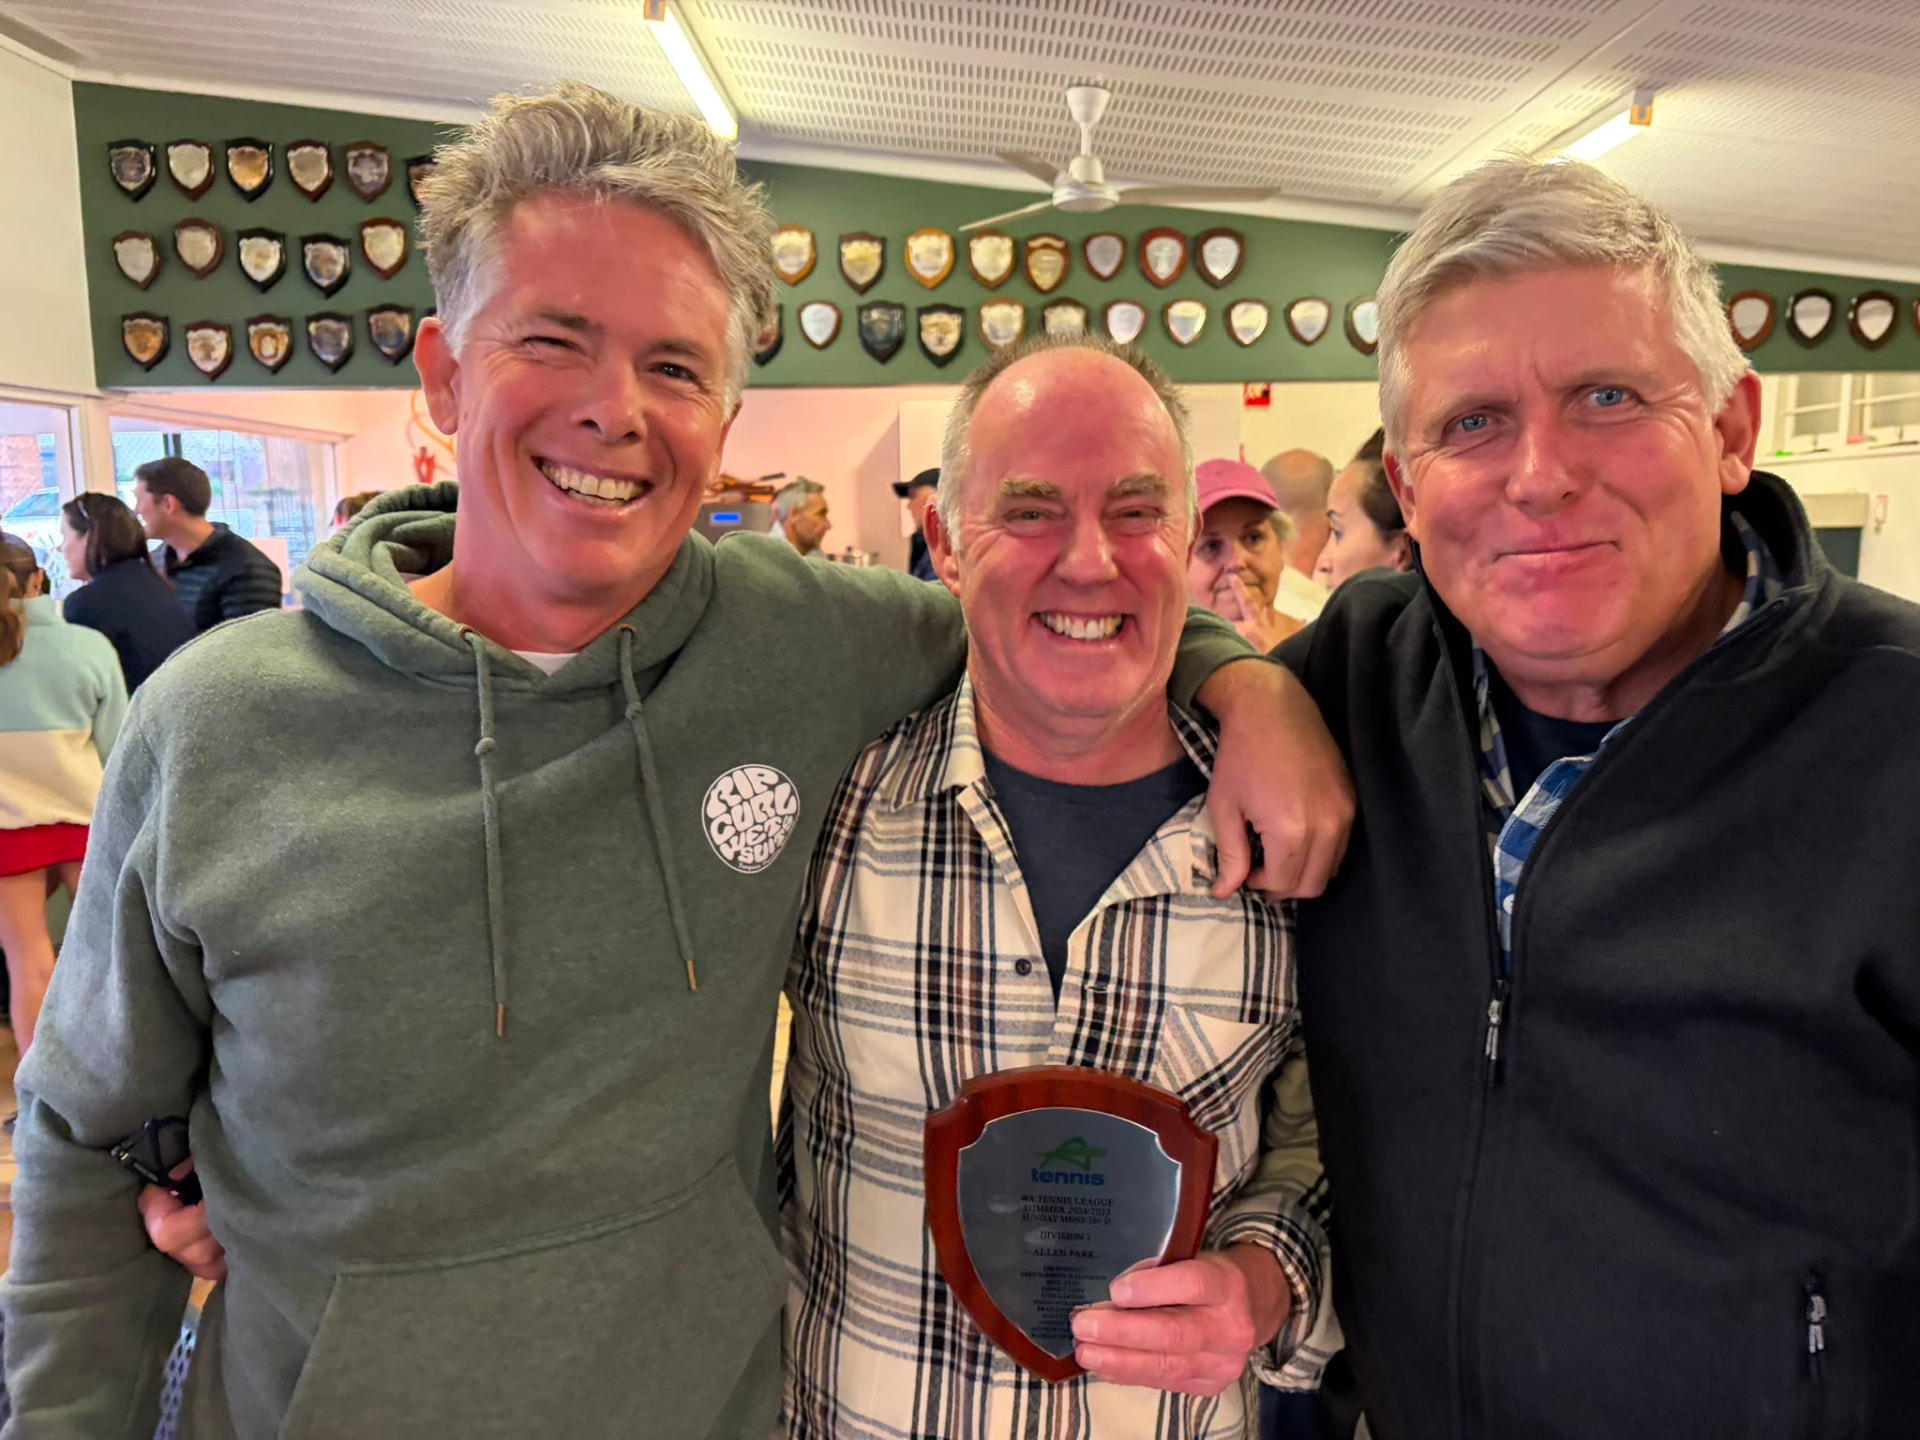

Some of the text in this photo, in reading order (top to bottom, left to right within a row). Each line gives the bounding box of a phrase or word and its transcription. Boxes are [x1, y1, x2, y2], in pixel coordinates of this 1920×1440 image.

[706, 767, 779, 819] RIP
[710, 782, 797, 846] CURL
[1031, 1167, 1105, 1186] tennis
[1020, 1194, 1114, 1207] WA TENNIS LEAGUE
[1023, 1204, 1066, 1214] SUMMER
[1022, 1213, 1058, 1224] SUNDAY
[1040, 1231, 1084, 1241] DIVISION
[1033, 1248, 1095, 1258] ALLEN PARK
